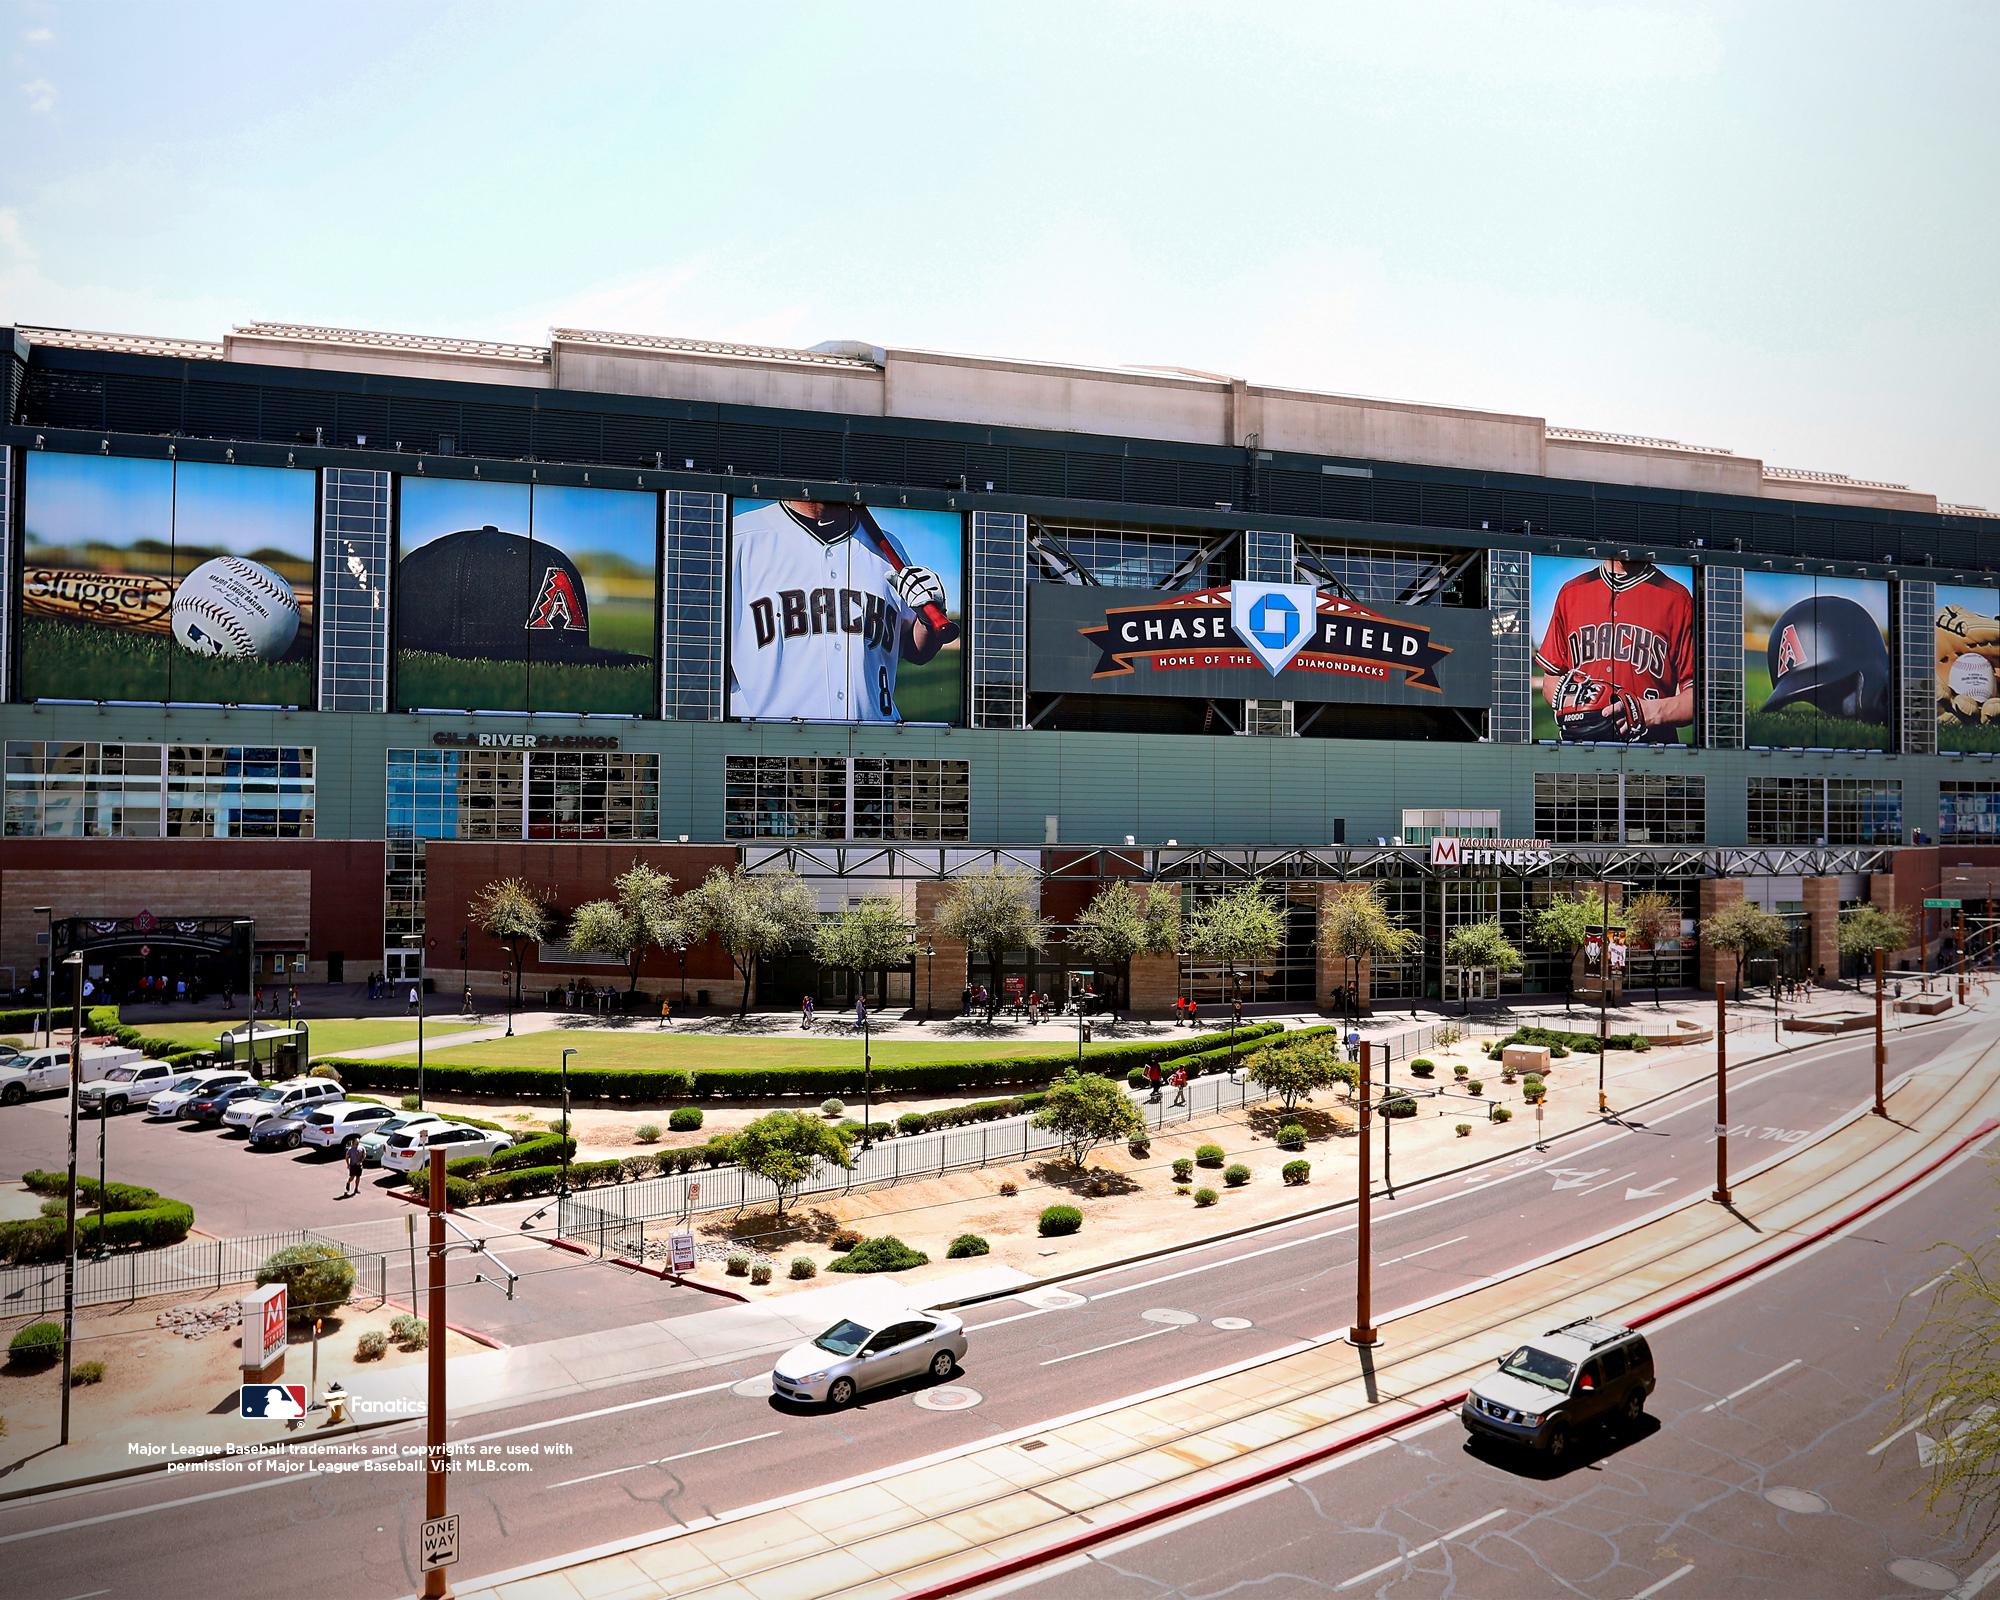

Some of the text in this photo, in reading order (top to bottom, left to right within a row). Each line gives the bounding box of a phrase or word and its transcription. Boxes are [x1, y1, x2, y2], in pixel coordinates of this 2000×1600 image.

[61, 571, 151, 588] LOUISVILLE
[233, 580, 254, 596] OFFICIAL
[29, 571, 160, 614] Slugger
[208, 574, 229, 587] MAJOR
[226, 583, 246, 598] LEAGUE
[244, 595, 270, 619] BASEBALL
[1121, 617, 1419, 656] CHASE FIELD
[1159, 655, 1384, 677] HOME OF THE DIAMONDBACKS
[478, 732, 537, 748] RIVER
[537, 734, 620, 749] CASINOS
[1435, 841, 1552, 866] M FITNESS
[1460, 838, 1551, 849] MOUNTAINSIDE
[265, 1293, 284, 1333] M
[425, 1519, 455, 1537] ONE
[424, 1532, 456, 1552] WAY
